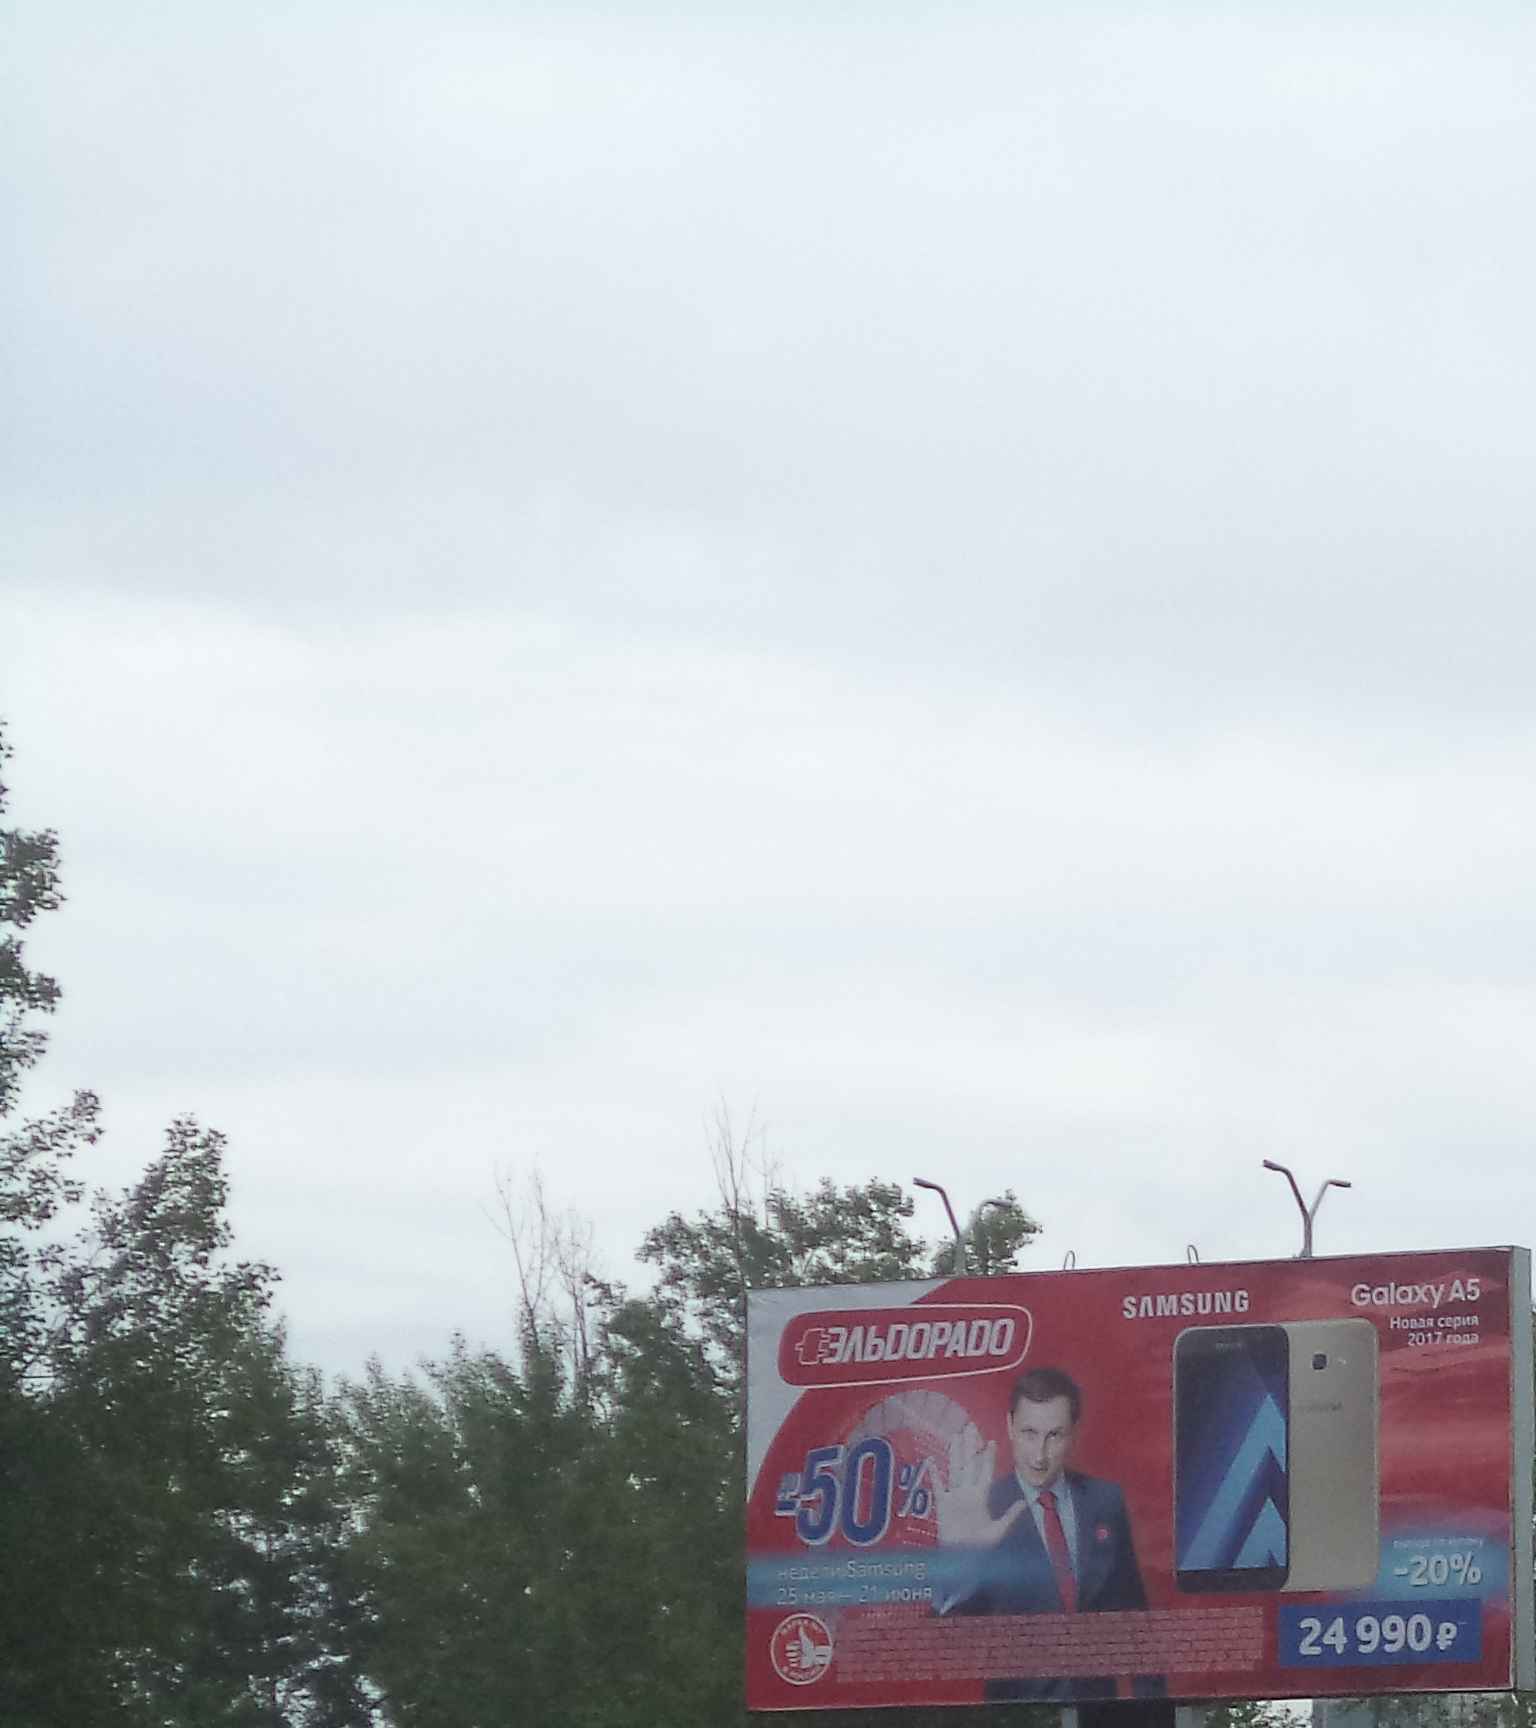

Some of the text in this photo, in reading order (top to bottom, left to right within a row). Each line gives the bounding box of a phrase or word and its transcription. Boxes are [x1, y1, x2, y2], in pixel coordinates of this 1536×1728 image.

[1122, 1290, 1249, 1319] SAMSUNG
[1351, 1278, 1481, 1309] Galaxy A5
[1389, 1314, 1480, 1331] Новая серия
[1407, 1331, 1480, 1346] 2017 года
[846, 1559, 929, 1581] Samsung
[1394, 1550, 1482, 1586] -20%
[1298, 1616, 1348, 1656] 24
